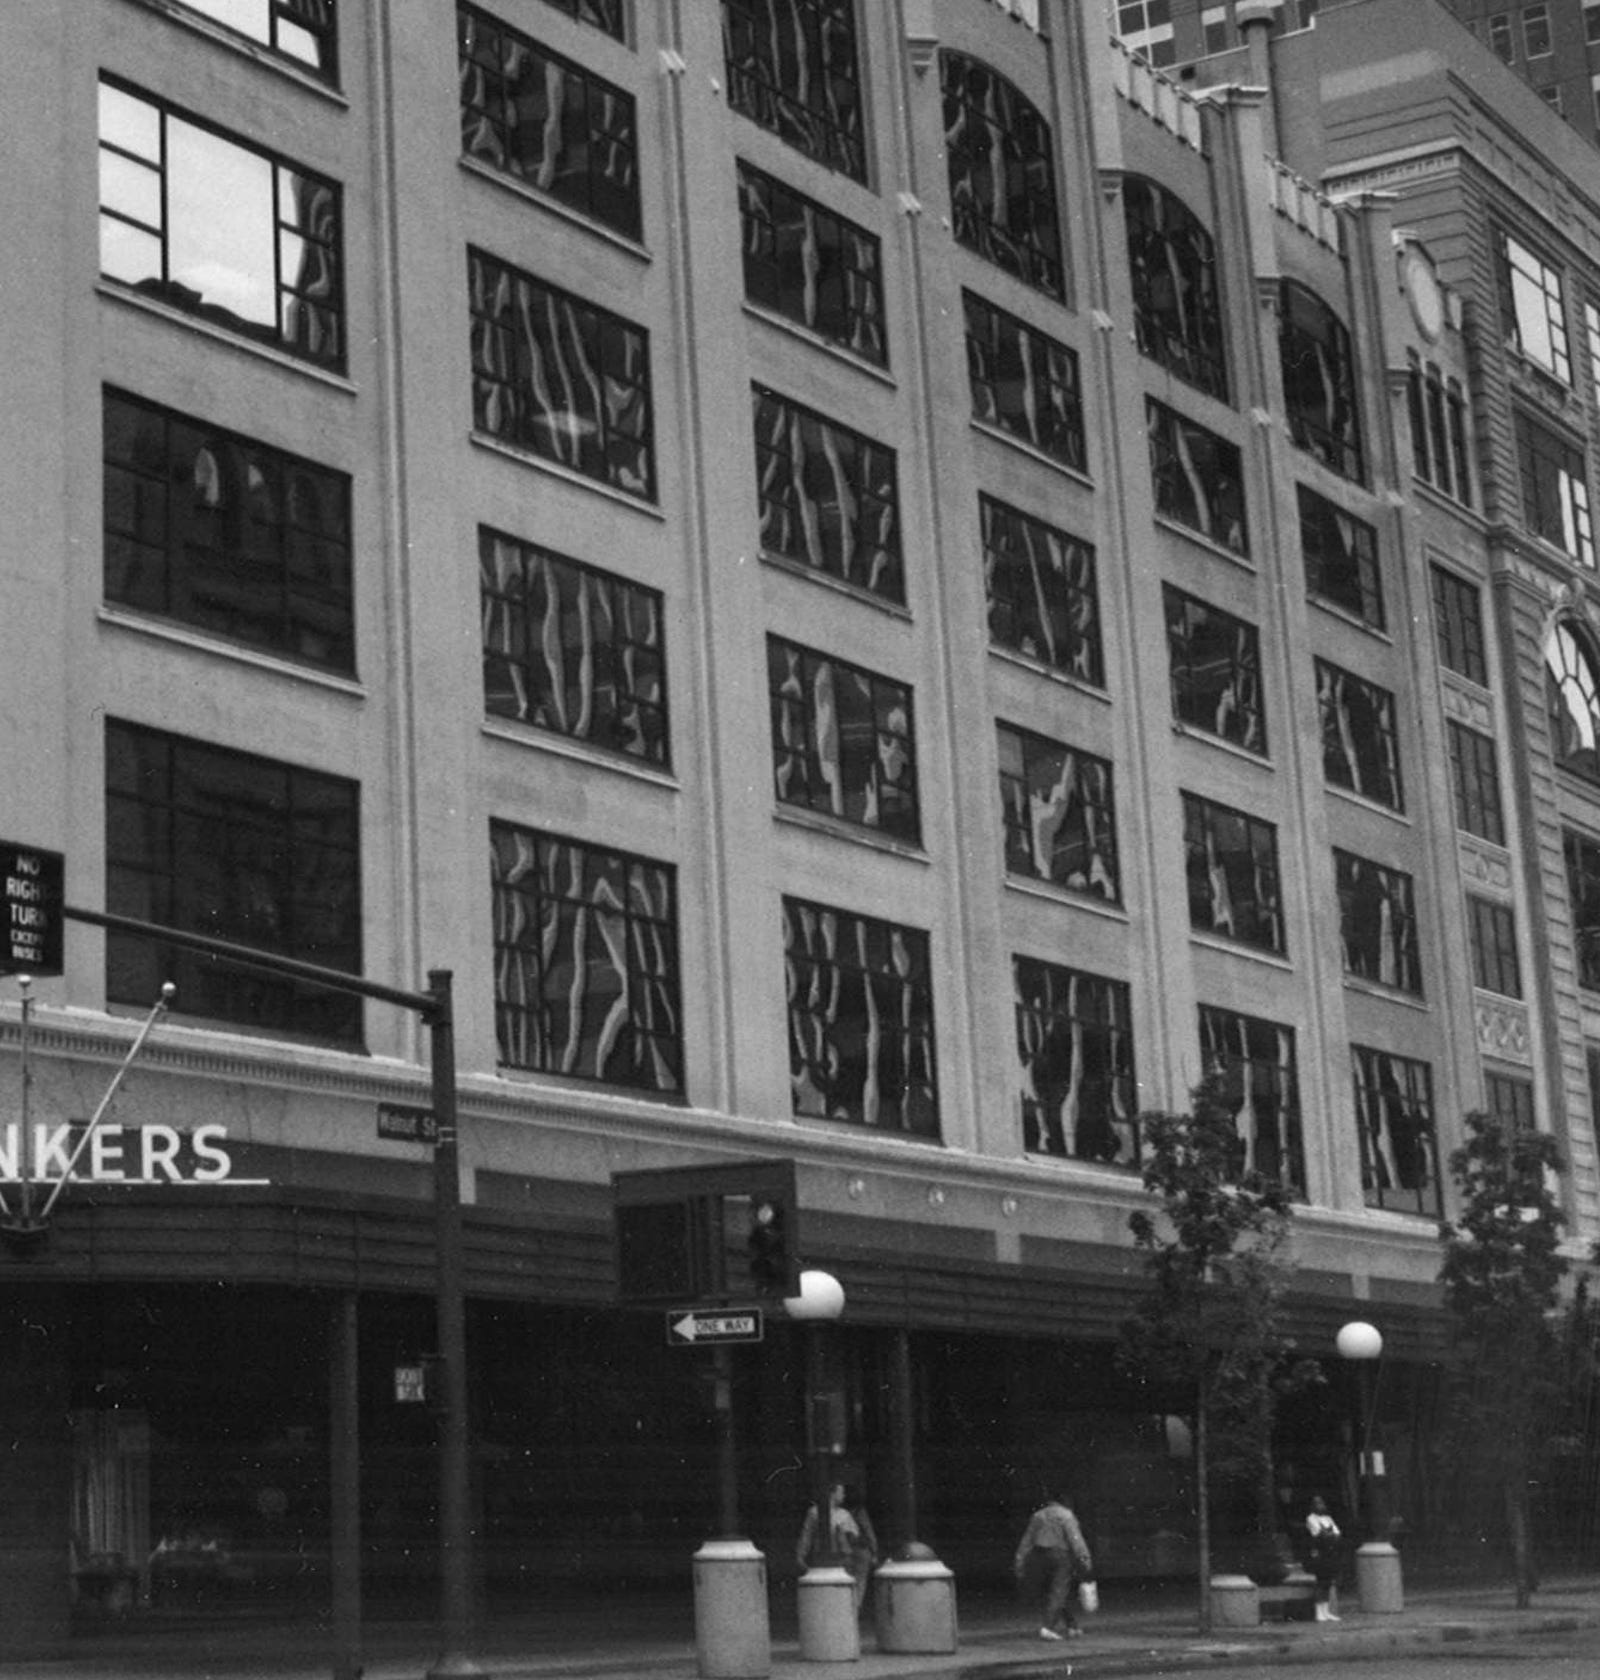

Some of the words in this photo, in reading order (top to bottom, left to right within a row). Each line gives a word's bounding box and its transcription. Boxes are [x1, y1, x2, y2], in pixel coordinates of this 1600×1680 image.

[16, 856, 40, 875] NO
[6, 877, 42, 901] RIGH
[696, 1319, 719, 1333] ONE
[725, 1318, 750, 1332] WAY
